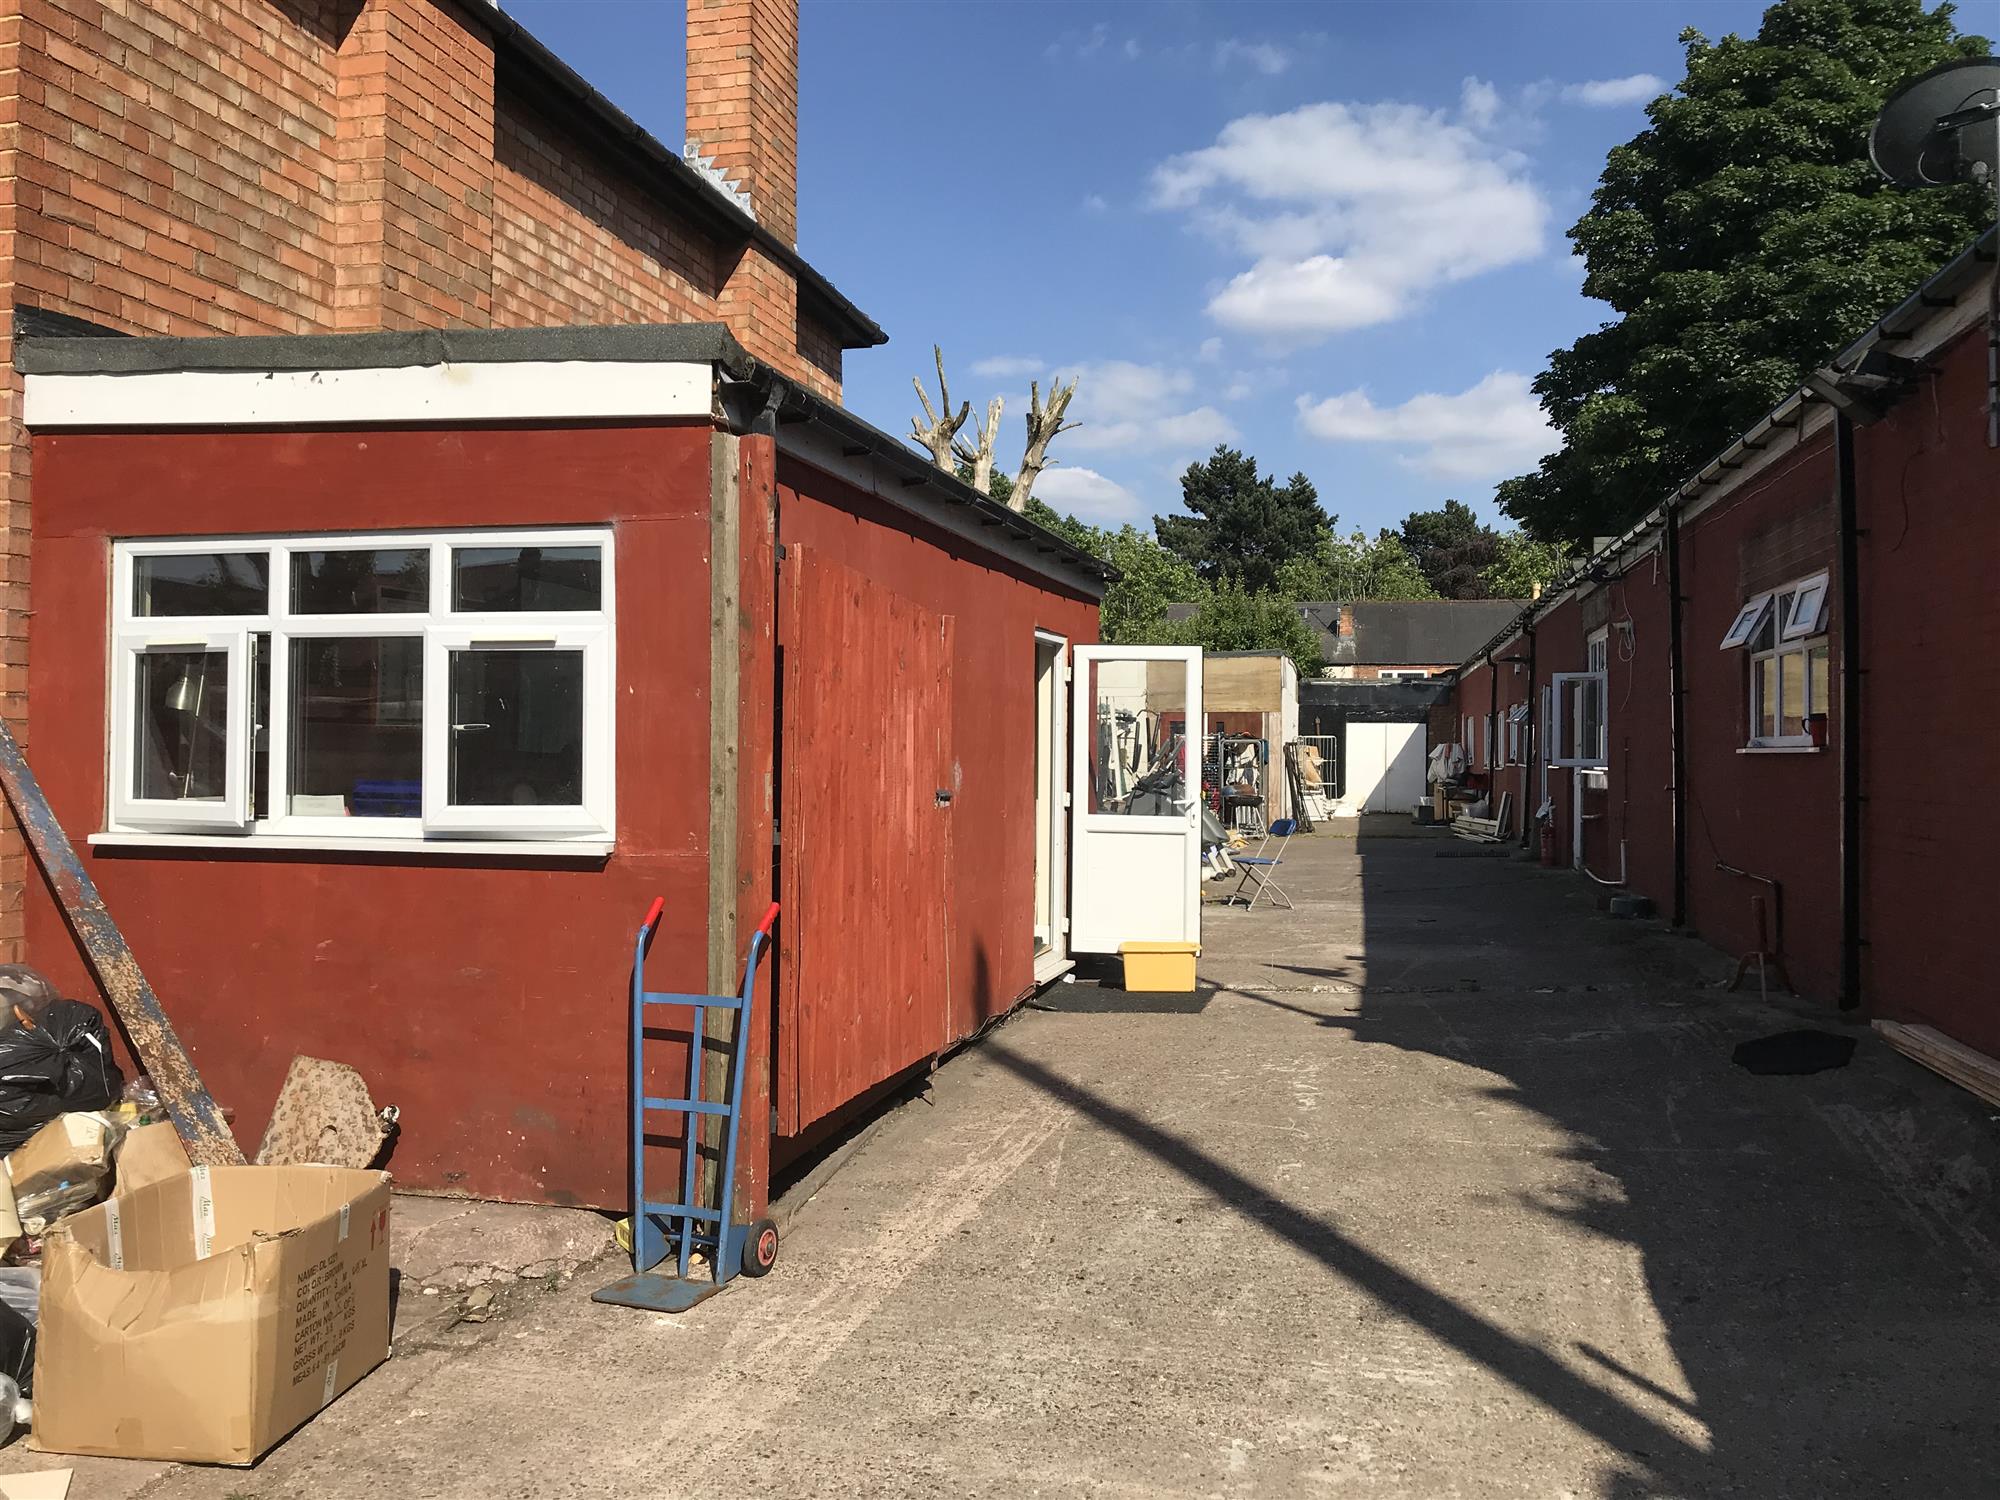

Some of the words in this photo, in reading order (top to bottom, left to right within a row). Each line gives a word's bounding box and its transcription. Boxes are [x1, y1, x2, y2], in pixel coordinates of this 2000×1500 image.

[294, 1318, 322, 1343] CARTON
[293, 1348, 316, 1372] GROSS
[294, 1339, 306, 1357] NET
